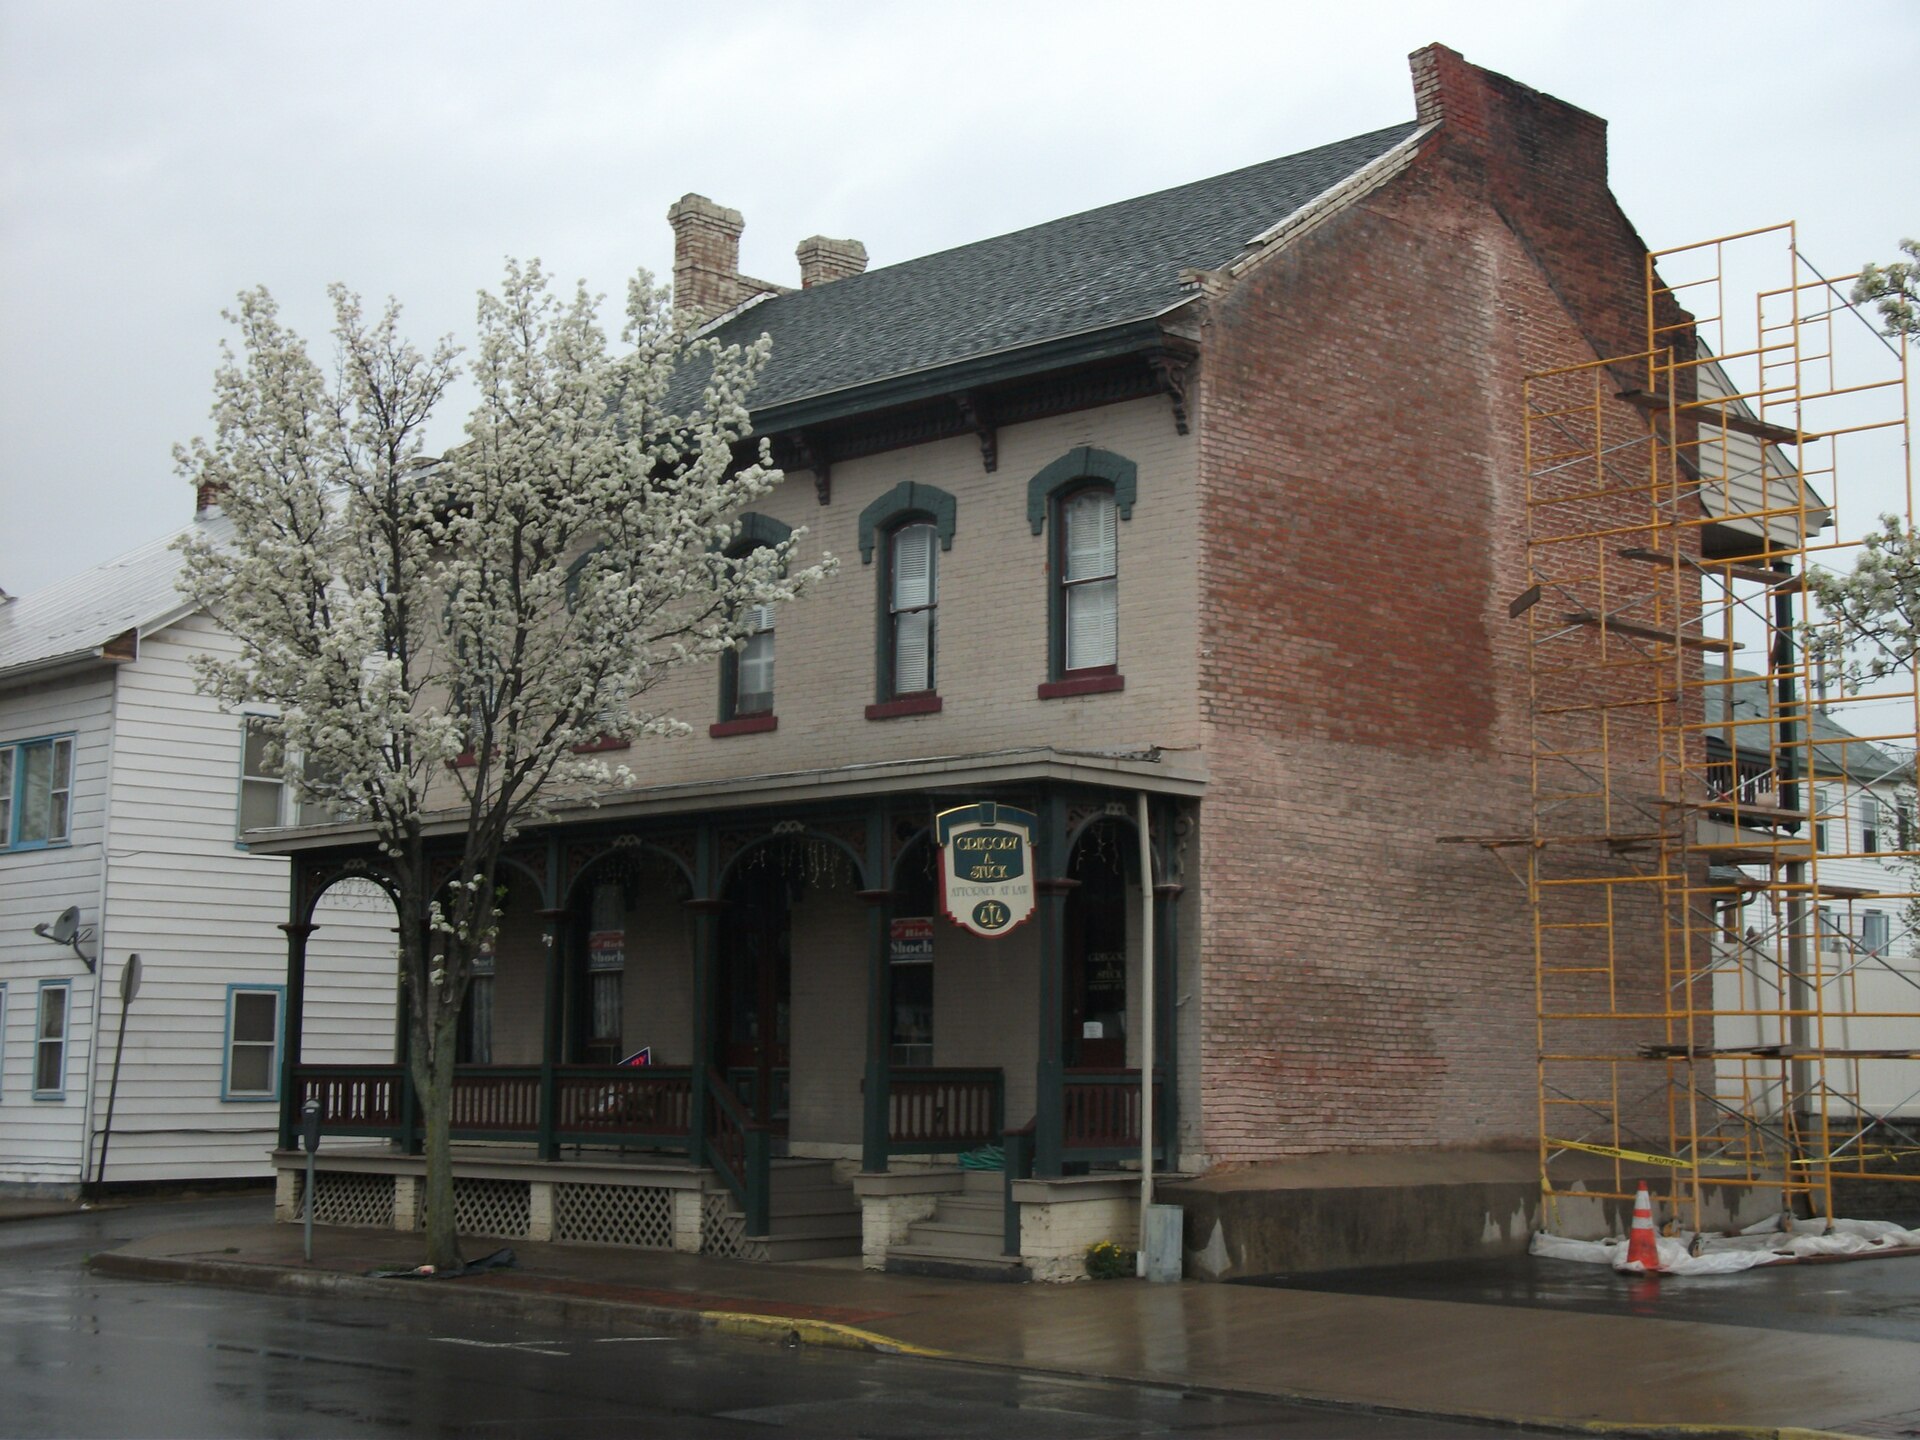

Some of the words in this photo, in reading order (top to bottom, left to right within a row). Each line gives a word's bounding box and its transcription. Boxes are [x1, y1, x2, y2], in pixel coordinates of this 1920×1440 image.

[957, 837, 1018, 850] GREGORY
[970, 865, 1008, 879] STUCK
[950, 886, 995, 897] ATTORNEY
[1000, 886, 1009, 896] AT
[1012, 885, 1030, 896] LAW
[1587, 1145, 1621, 1156] CAUTION
[1647, 1156, 1683, 1166] CAUTION
